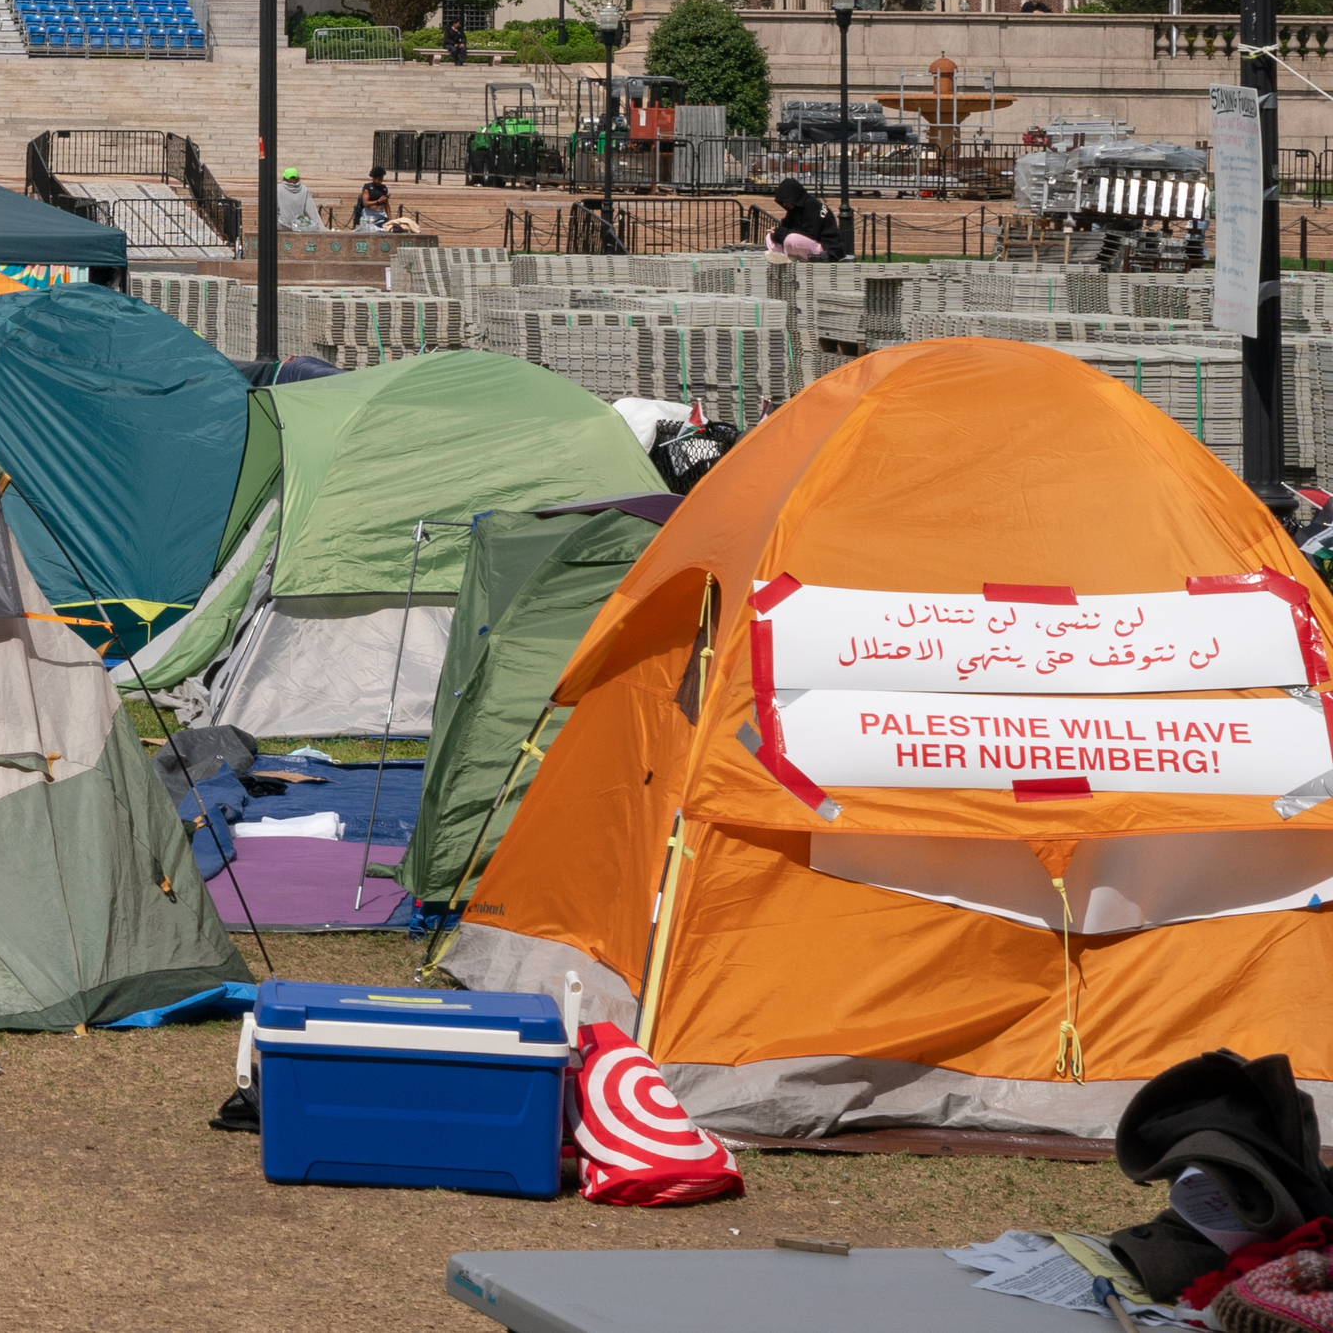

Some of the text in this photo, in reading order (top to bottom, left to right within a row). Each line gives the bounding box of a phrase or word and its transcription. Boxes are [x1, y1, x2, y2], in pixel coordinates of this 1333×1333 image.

[987, 606, 1018, 634] لن
[1113, 606, 1145, 638] لن
[838, 636, 1221, 681] لن نتوقف حتى ينتهي الاحتلال
[859, 712, 1253, 745] PALESTINE WILL HAVE
[895, 743, 1221, 774] HER NUREMBERG!
